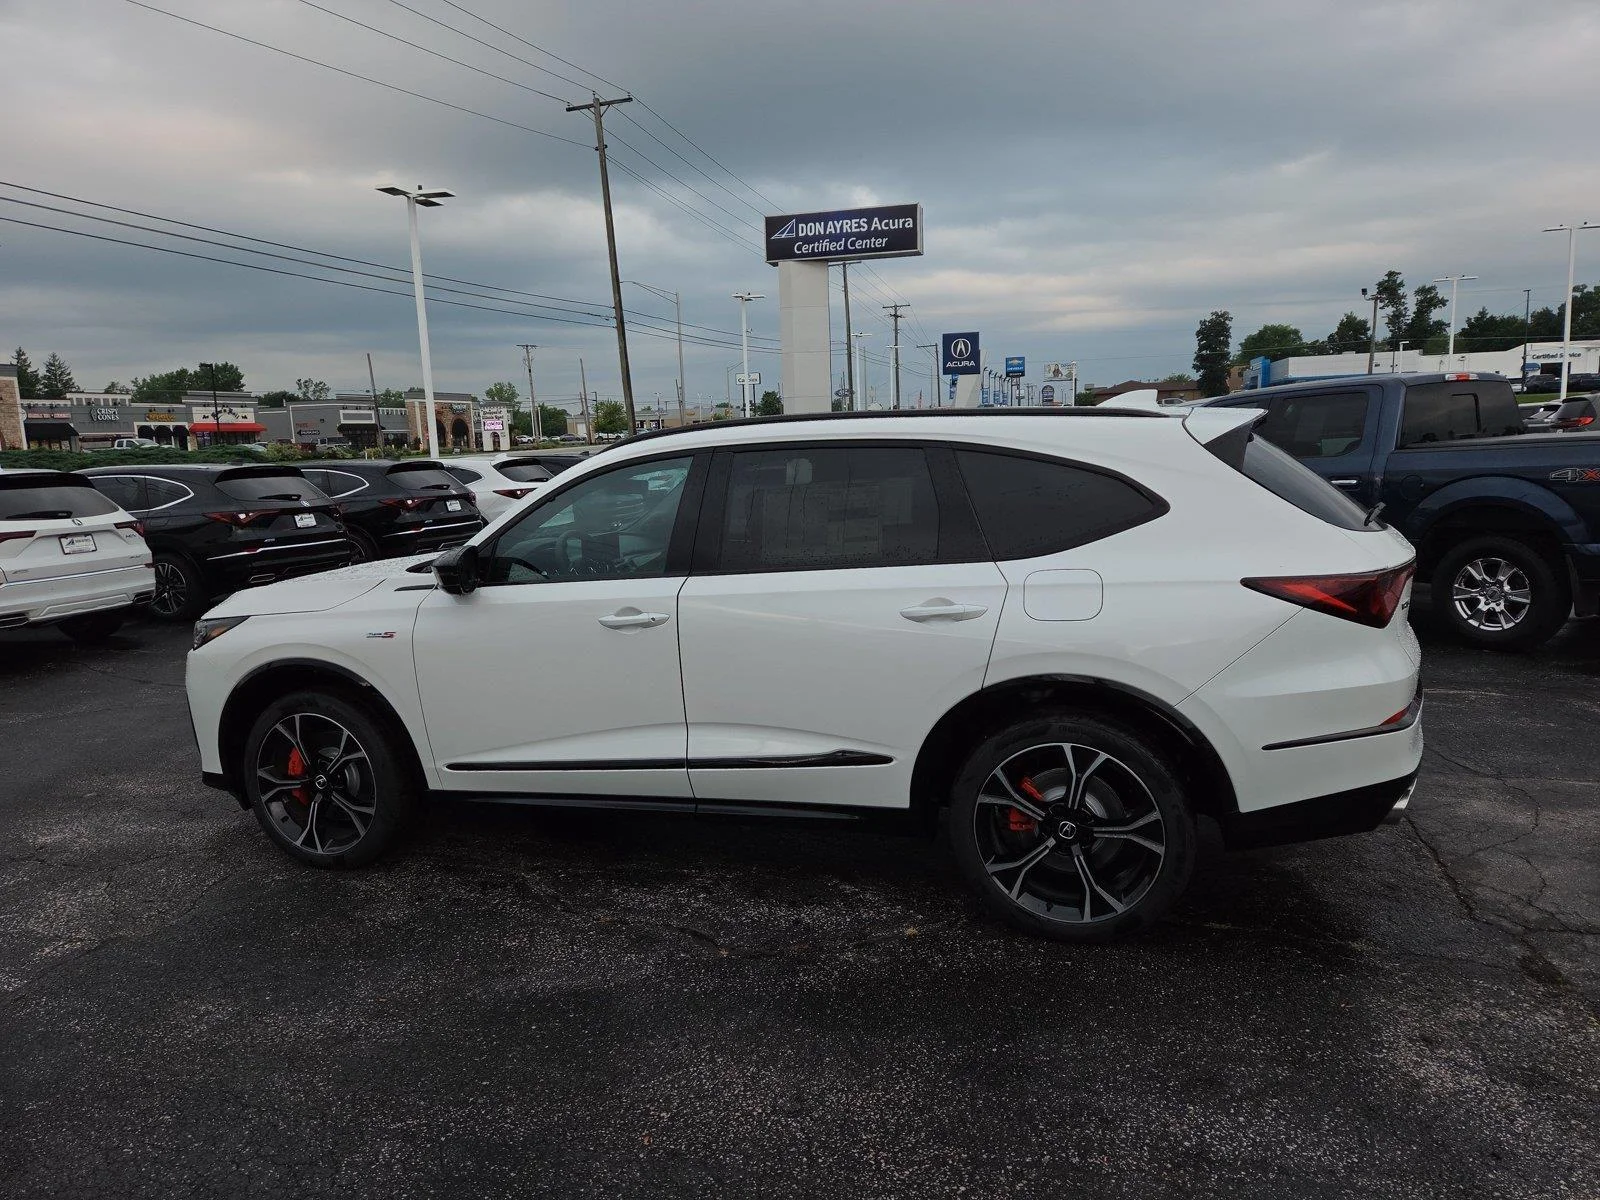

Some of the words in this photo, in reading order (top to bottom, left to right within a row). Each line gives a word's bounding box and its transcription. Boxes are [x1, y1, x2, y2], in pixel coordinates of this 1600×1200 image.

[798, 222, 825, 237] DON
[826, 218, 868, 235] AYRES
[870, 217, 914, 231] Acura
[794, 238, 845, 254] Certified
[847, 236, 889, 250] Center
[1531, 352, 1559, 360] Certified
[1559, 351, 1582, 359] Svice
[946, 360, 976, 368] ACURA
[96, 407, 119, 415] CRISPY
